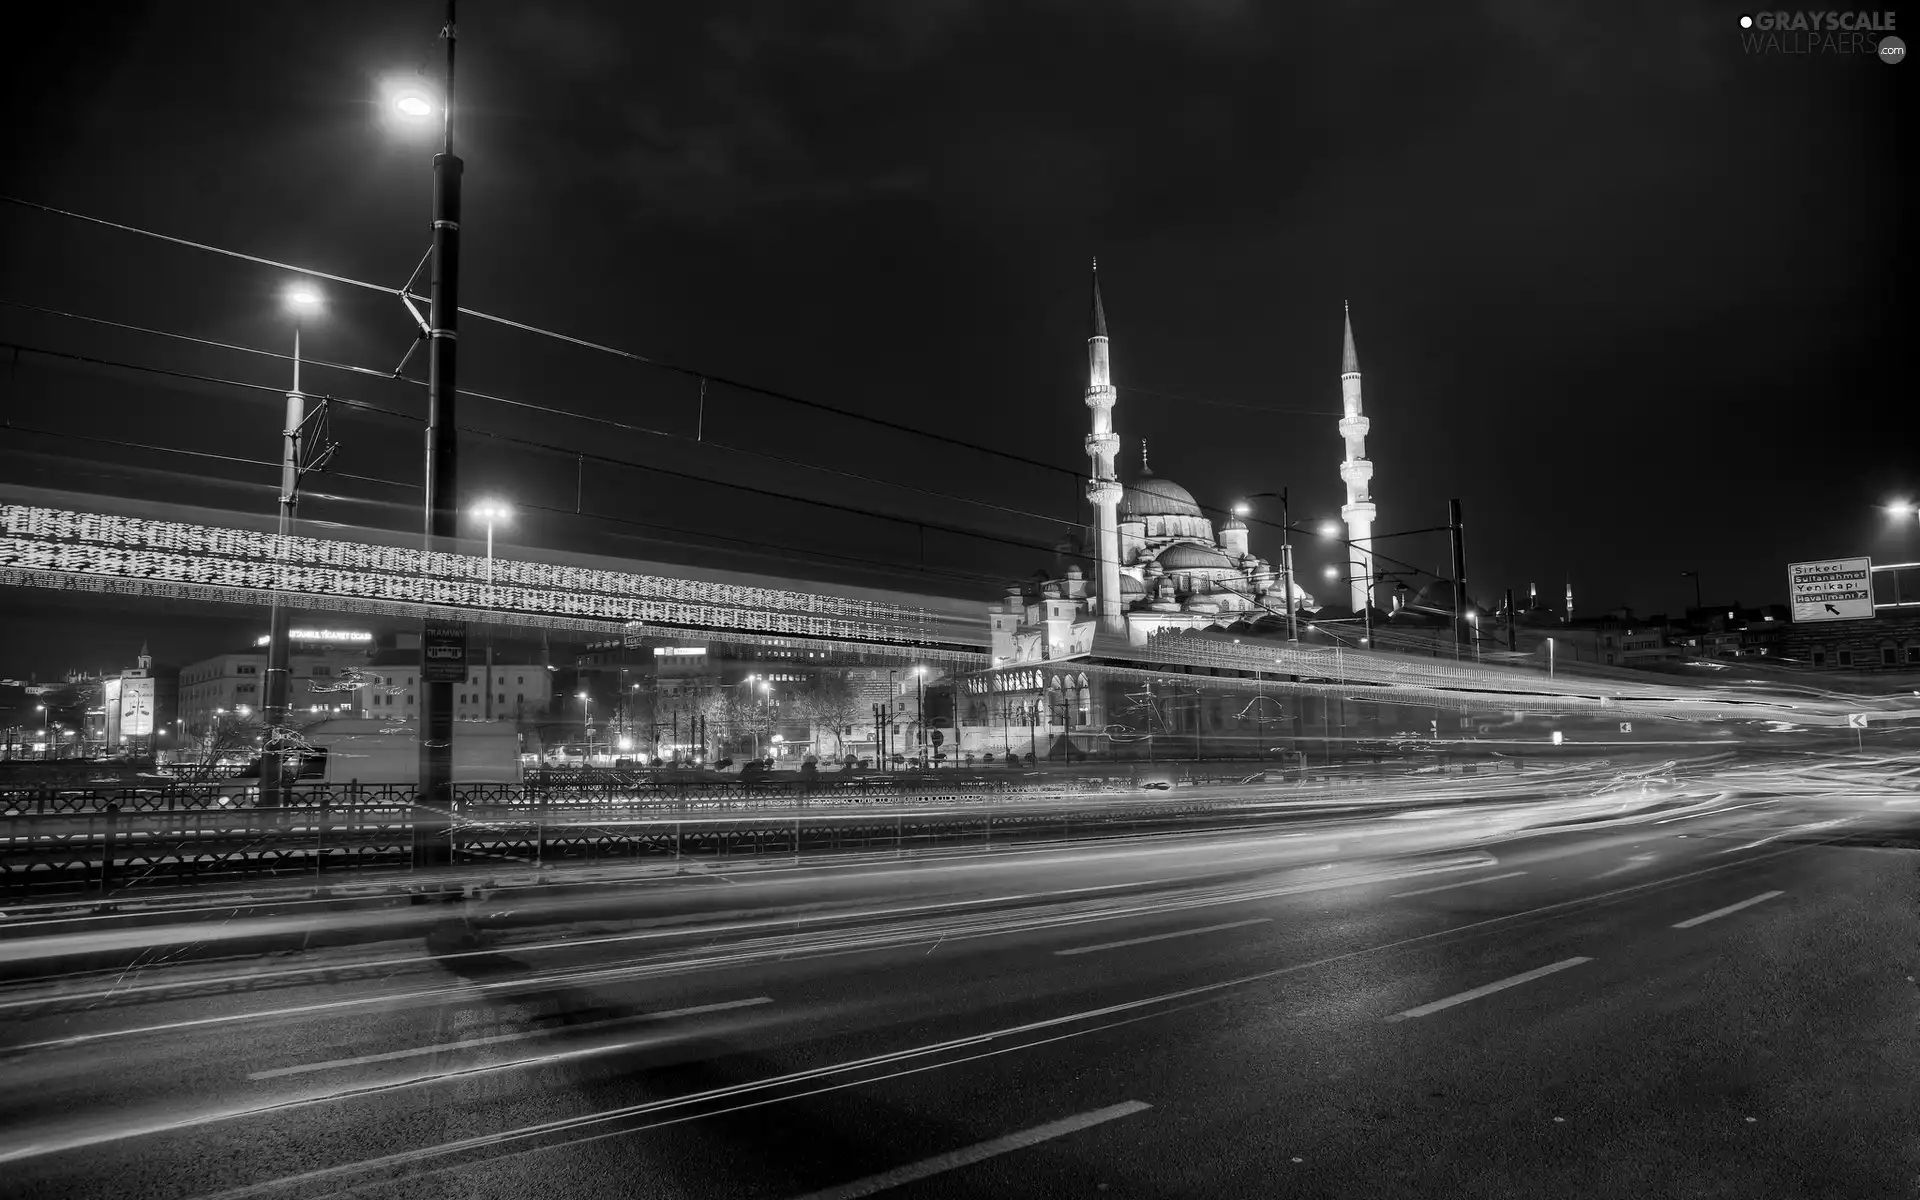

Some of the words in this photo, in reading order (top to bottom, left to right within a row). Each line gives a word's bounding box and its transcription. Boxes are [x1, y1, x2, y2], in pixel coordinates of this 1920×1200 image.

[1794, 564, 1843, 575] Sirkeci
[1795, 571, 1865, 583] Sultanahmet
[1797, 582, 1858, 592] Yenikapı
